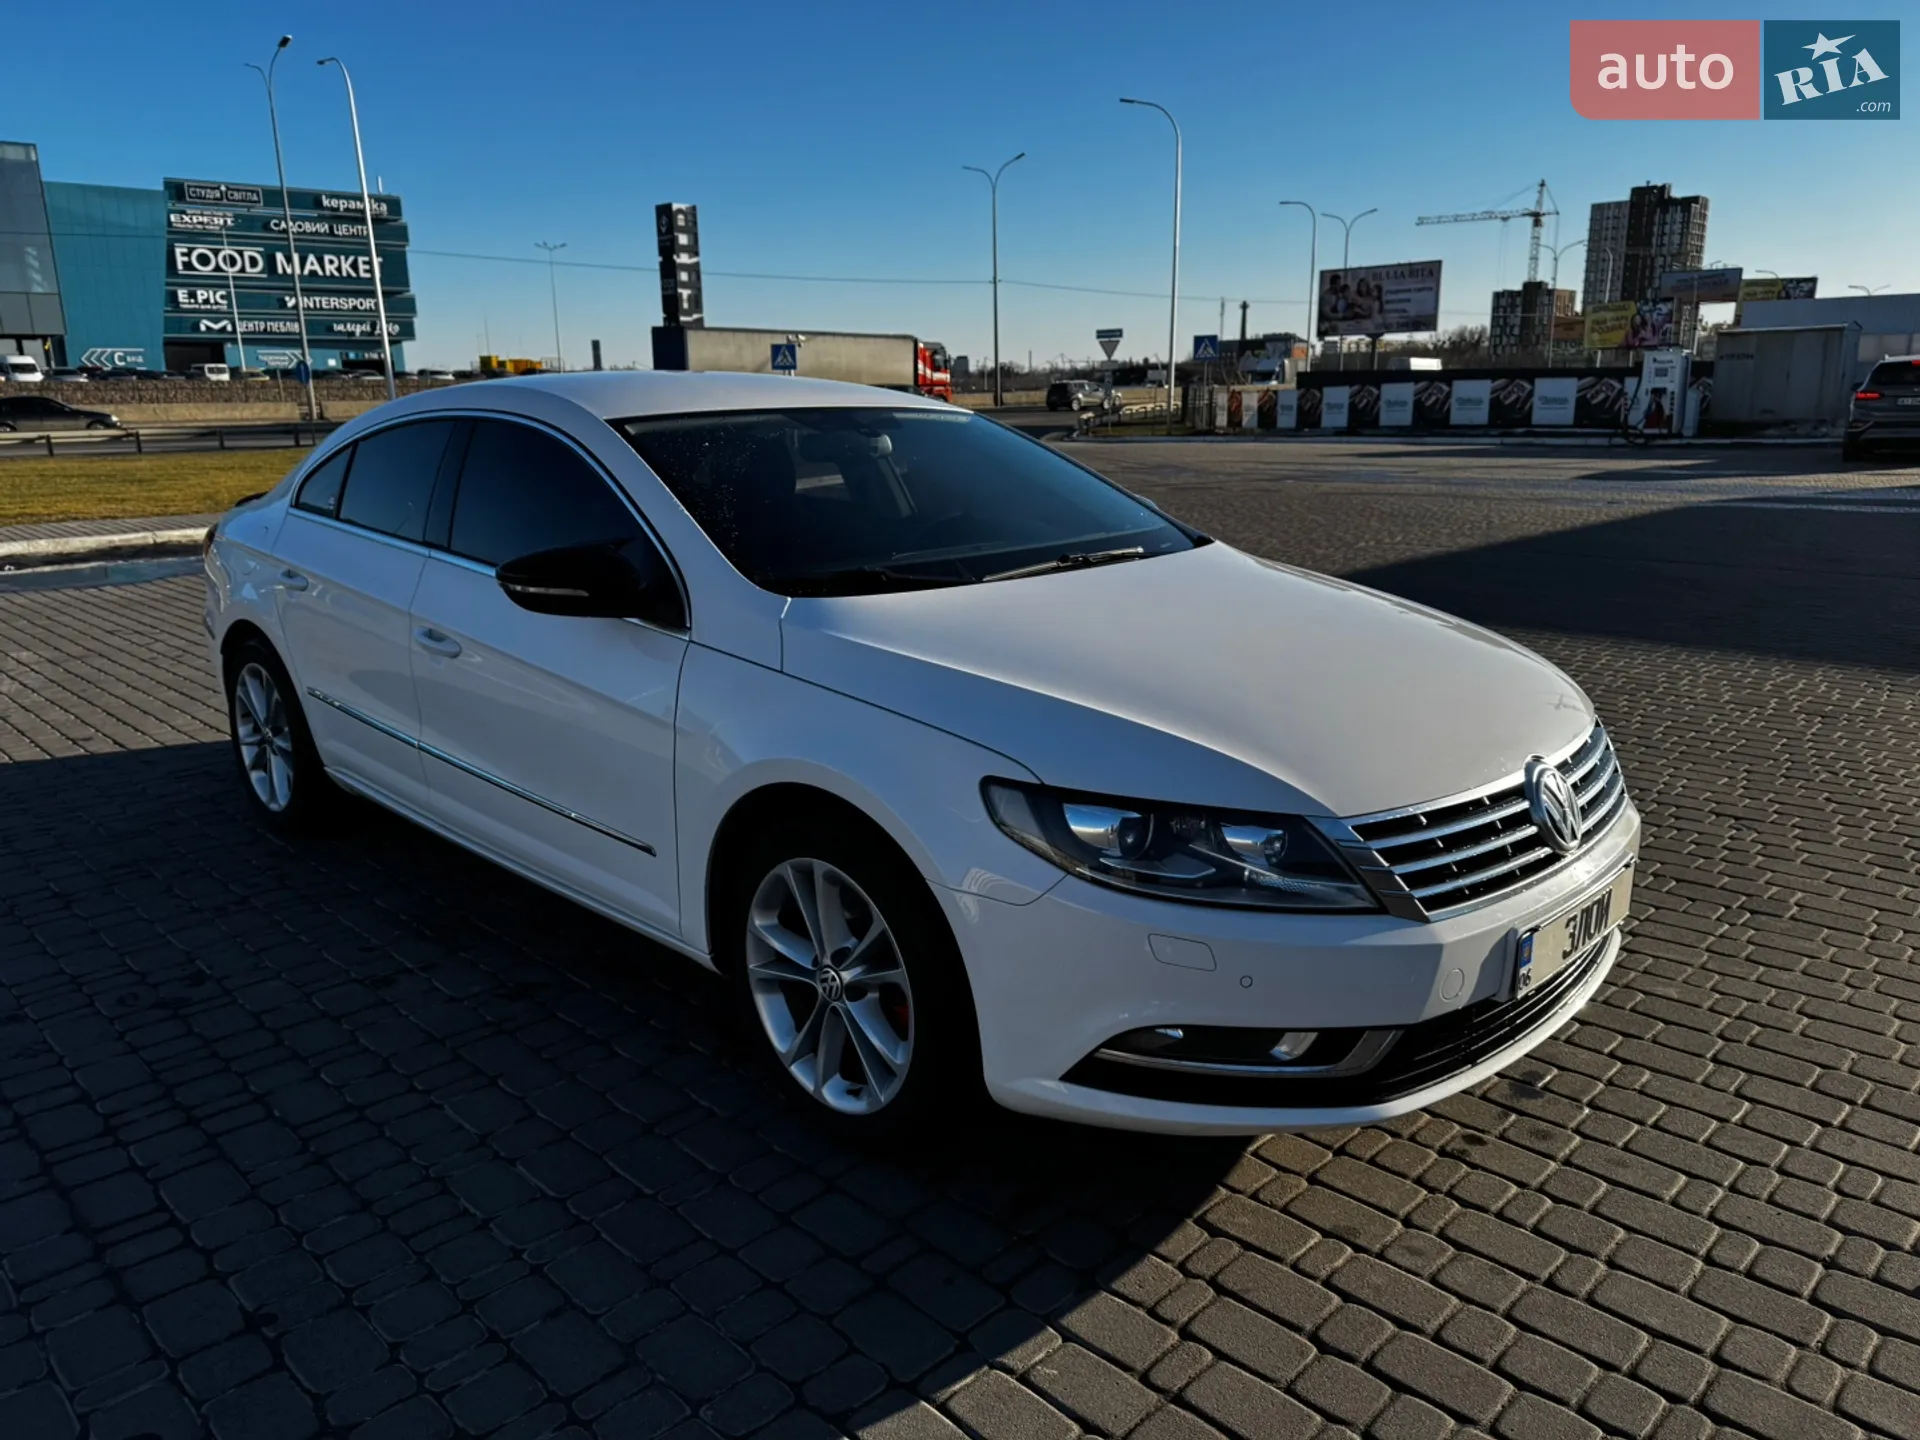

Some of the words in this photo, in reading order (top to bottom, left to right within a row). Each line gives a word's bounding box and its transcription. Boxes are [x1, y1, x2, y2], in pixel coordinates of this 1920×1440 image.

[270, 219, 330, 235] САДОВИЙ
[174, 246, 264, 274] FOOD
[177, 288, 228, 305] E.PIC
[300, 295, 378, 311] NTERSPOR
